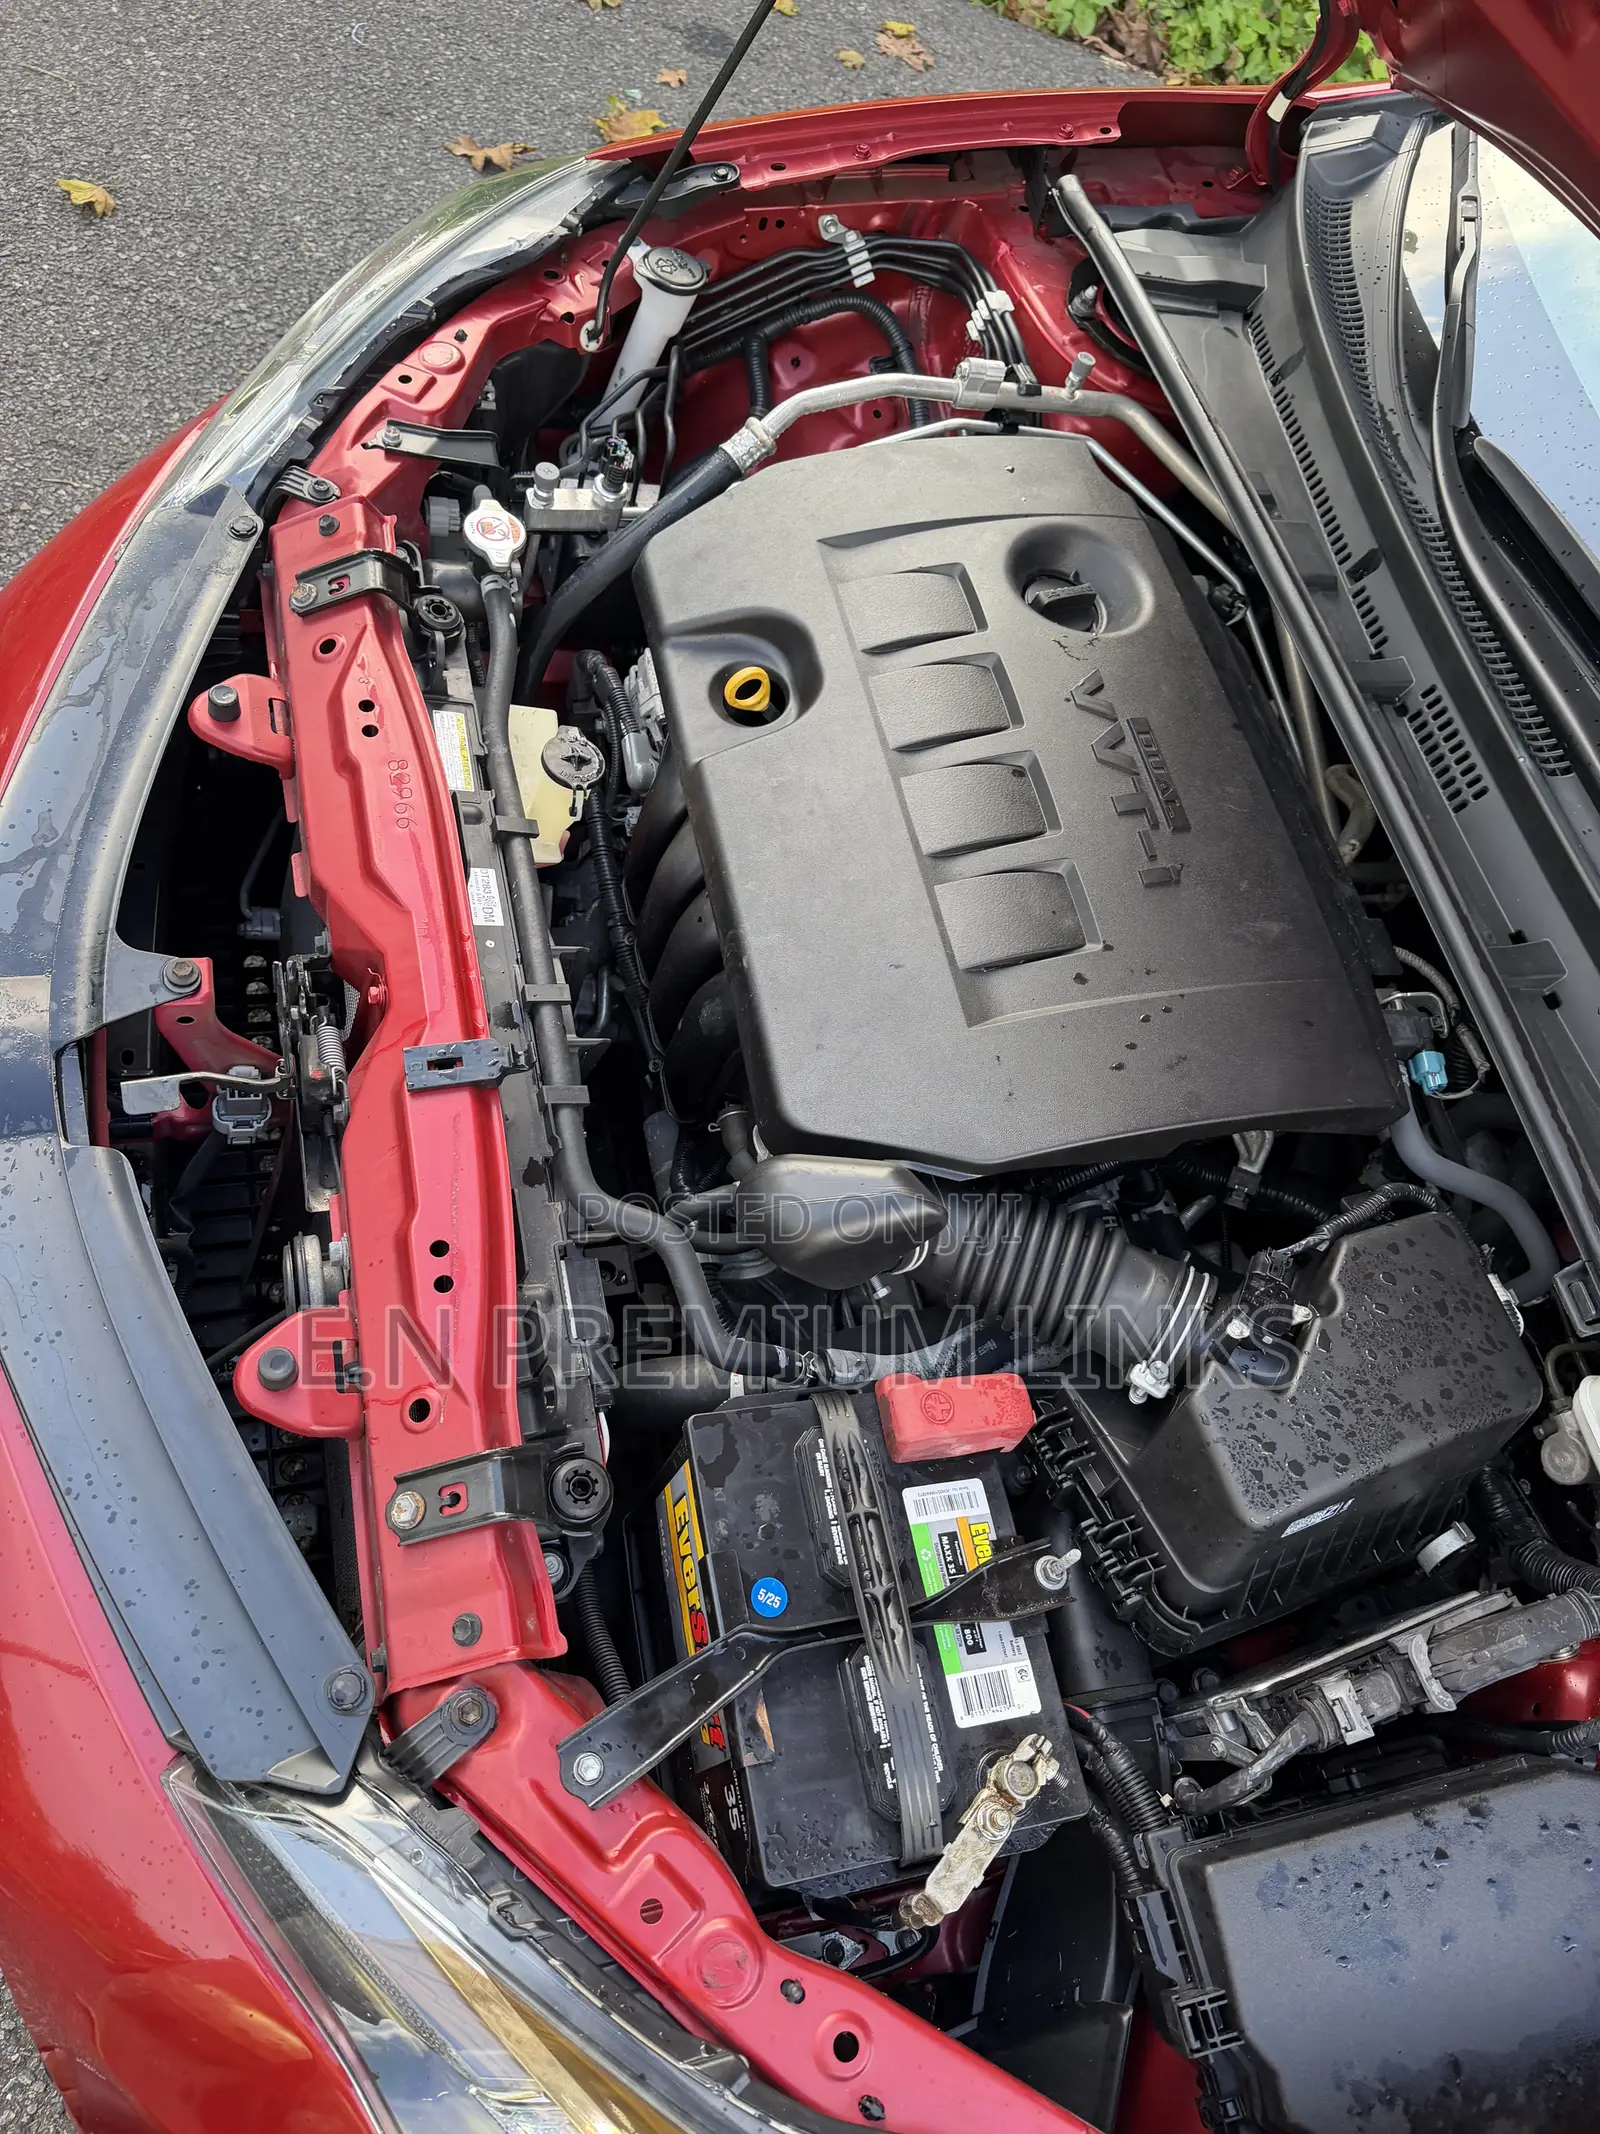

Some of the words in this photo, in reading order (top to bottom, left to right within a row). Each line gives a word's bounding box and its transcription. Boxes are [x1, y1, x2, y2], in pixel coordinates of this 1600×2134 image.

[388, 760, 418, 829] 82966
[1070, 668, 1183, 886] VVT-i
[1137, 731, 1174, 819] DUAL
[940, 1535, 953, 1563] MAXX
[947, 1562, 956, 1575] 35
[757, 1588, 781, 1608] 5/25
[963, 1628, 974, 1646] 800
[724, 1783, 741, 1831] 35
